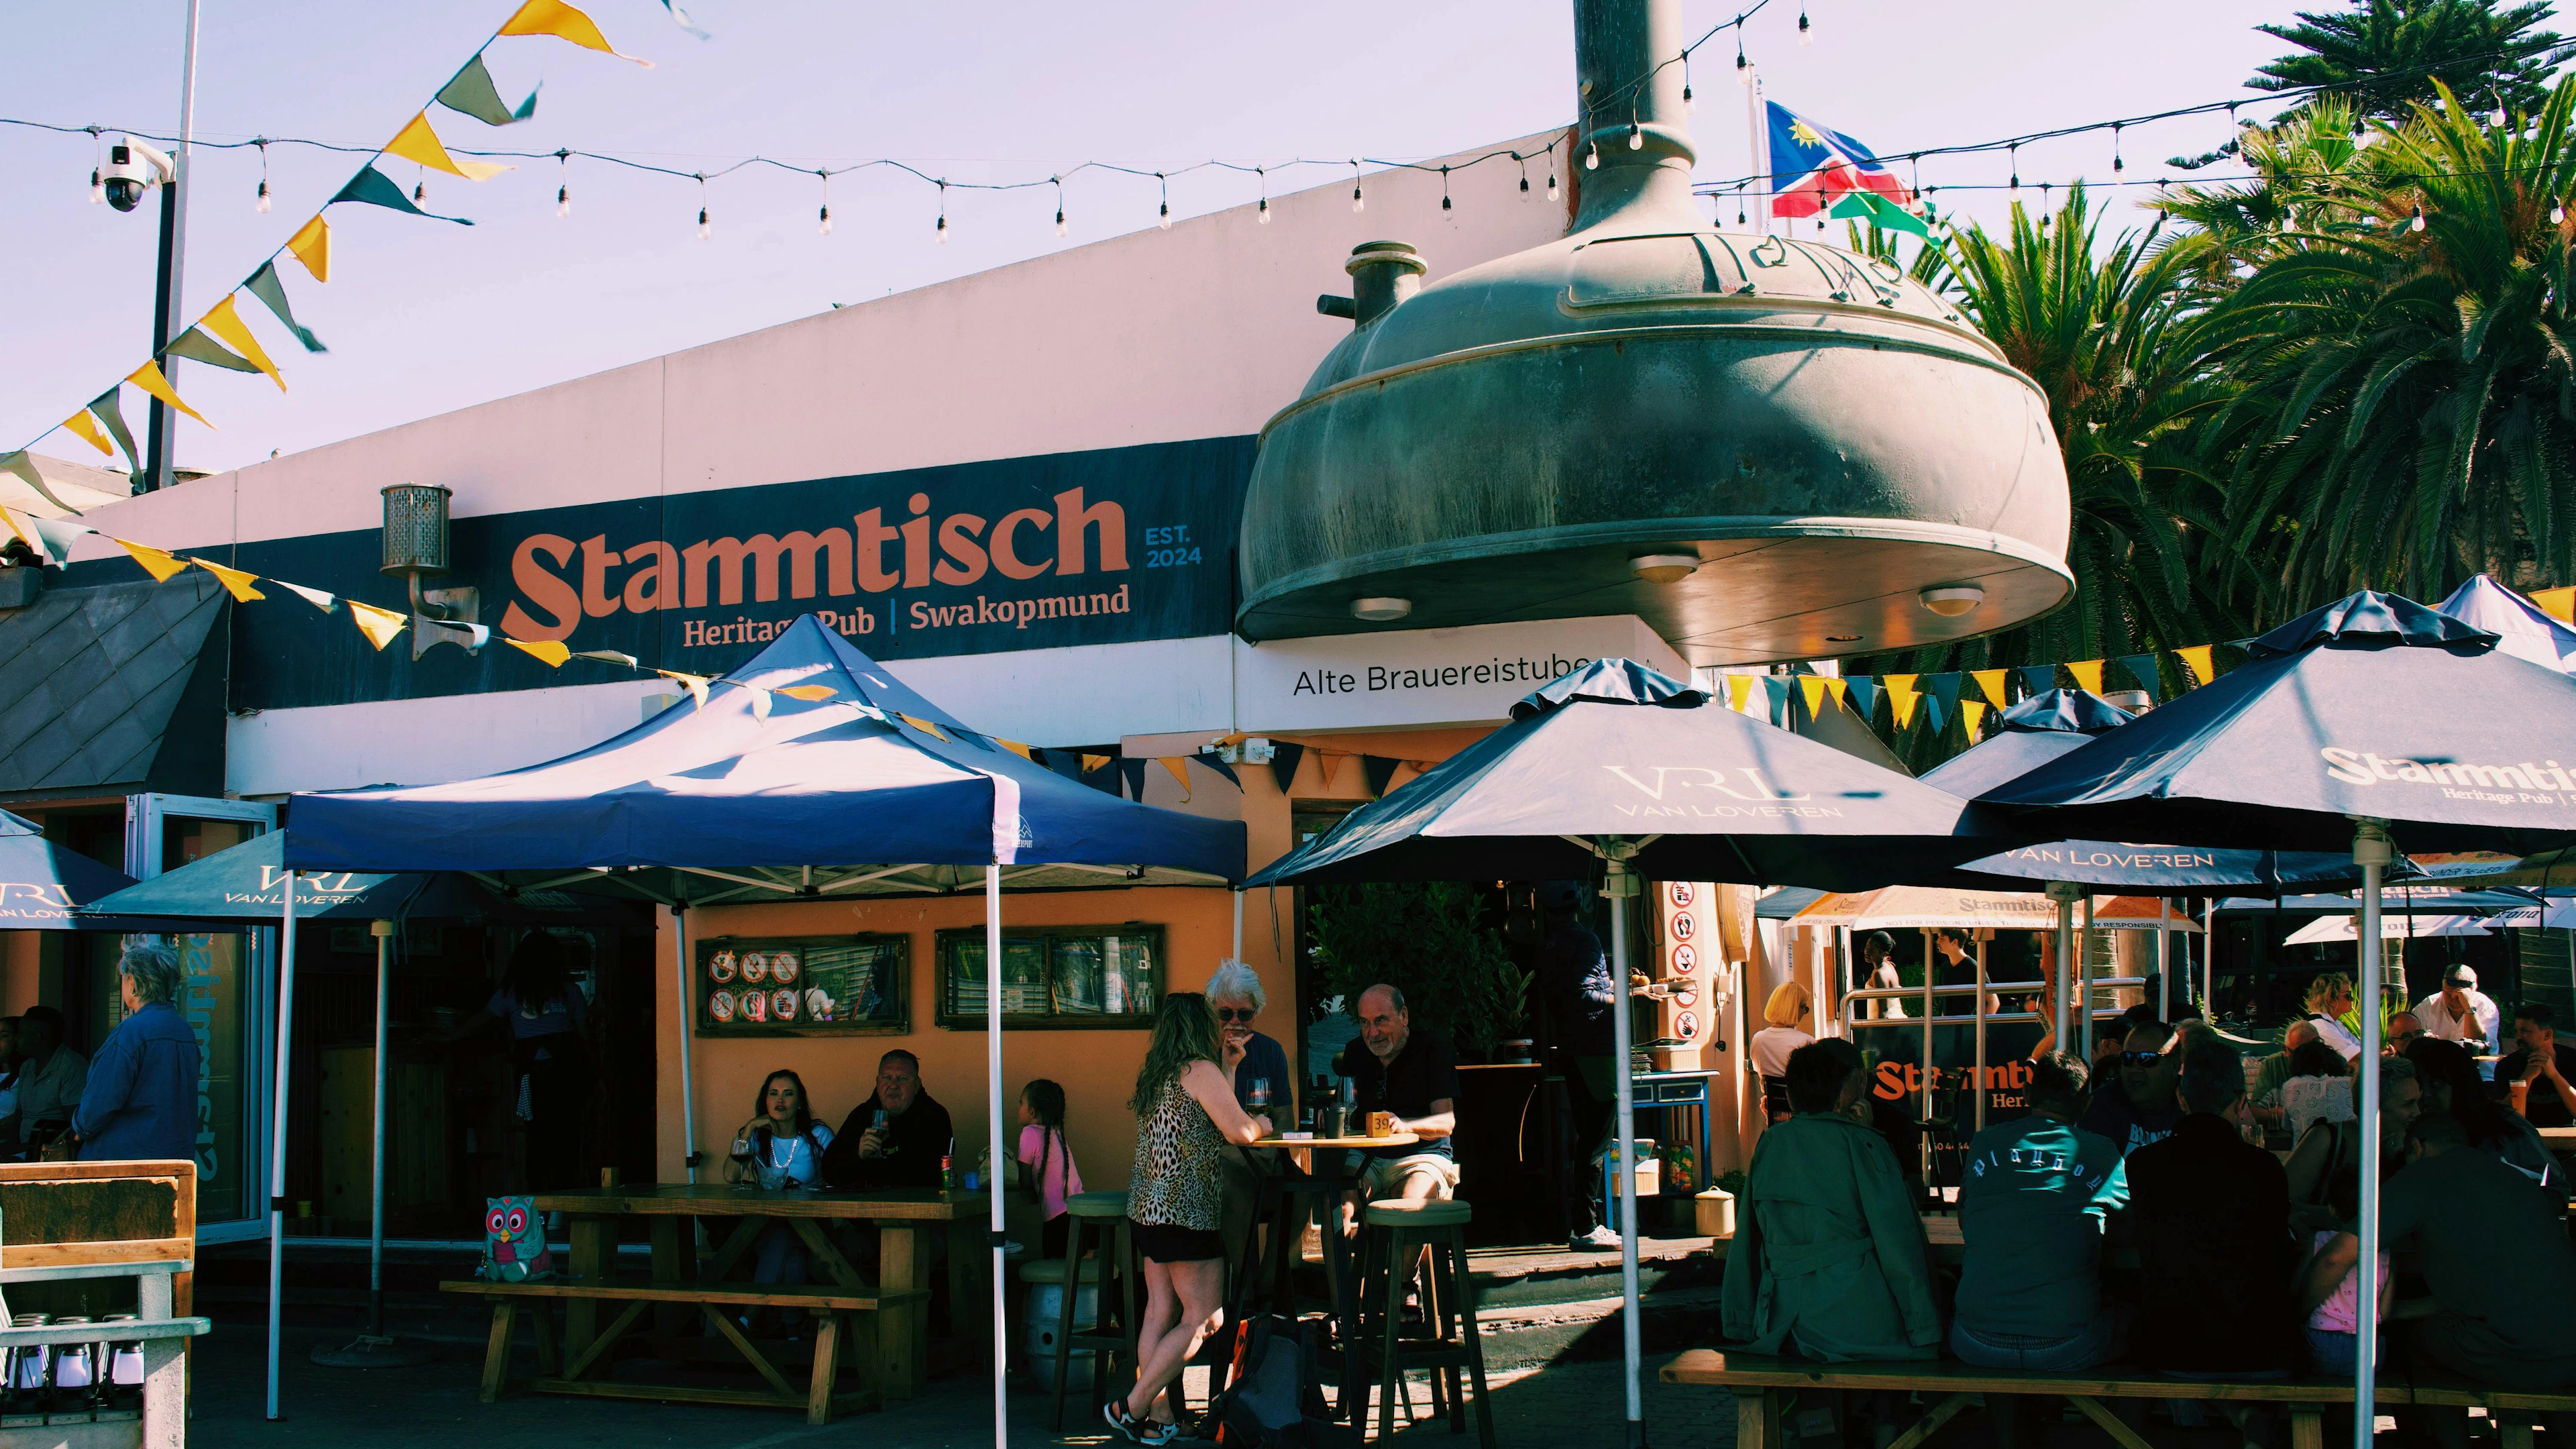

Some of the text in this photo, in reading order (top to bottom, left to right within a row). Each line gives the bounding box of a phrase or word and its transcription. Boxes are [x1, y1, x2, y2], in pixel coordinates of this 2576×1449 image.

[1145, 525, 1191, 545] EST.
[500, 486, 1130, 641] Stammtisch
[1146, 547, 1202, 568] 2024
[683, 584, 1130, 647] Herita Pub Swakopmund
[1293, 653, 1589, 696] Alte Brauereistube
[2320, 747, 2576, 792] Stammti
[1602, 765, 1811, 801] VRL
[2440, 788, 2516, 805] Heritage
[2518, 793, 2553, 805] Pub
[1613, 804, 1845, 817] VAN LOVEREN
[2005, 848, 2214, 867] VAN LOVEREN
[0, 882, 85, 908] RL
[225, 893, 368, 904] VAN LVEREN
[1959, 898, 2058, 913] Stammtisc
[1375, 1118, 1389, 1130] 39
